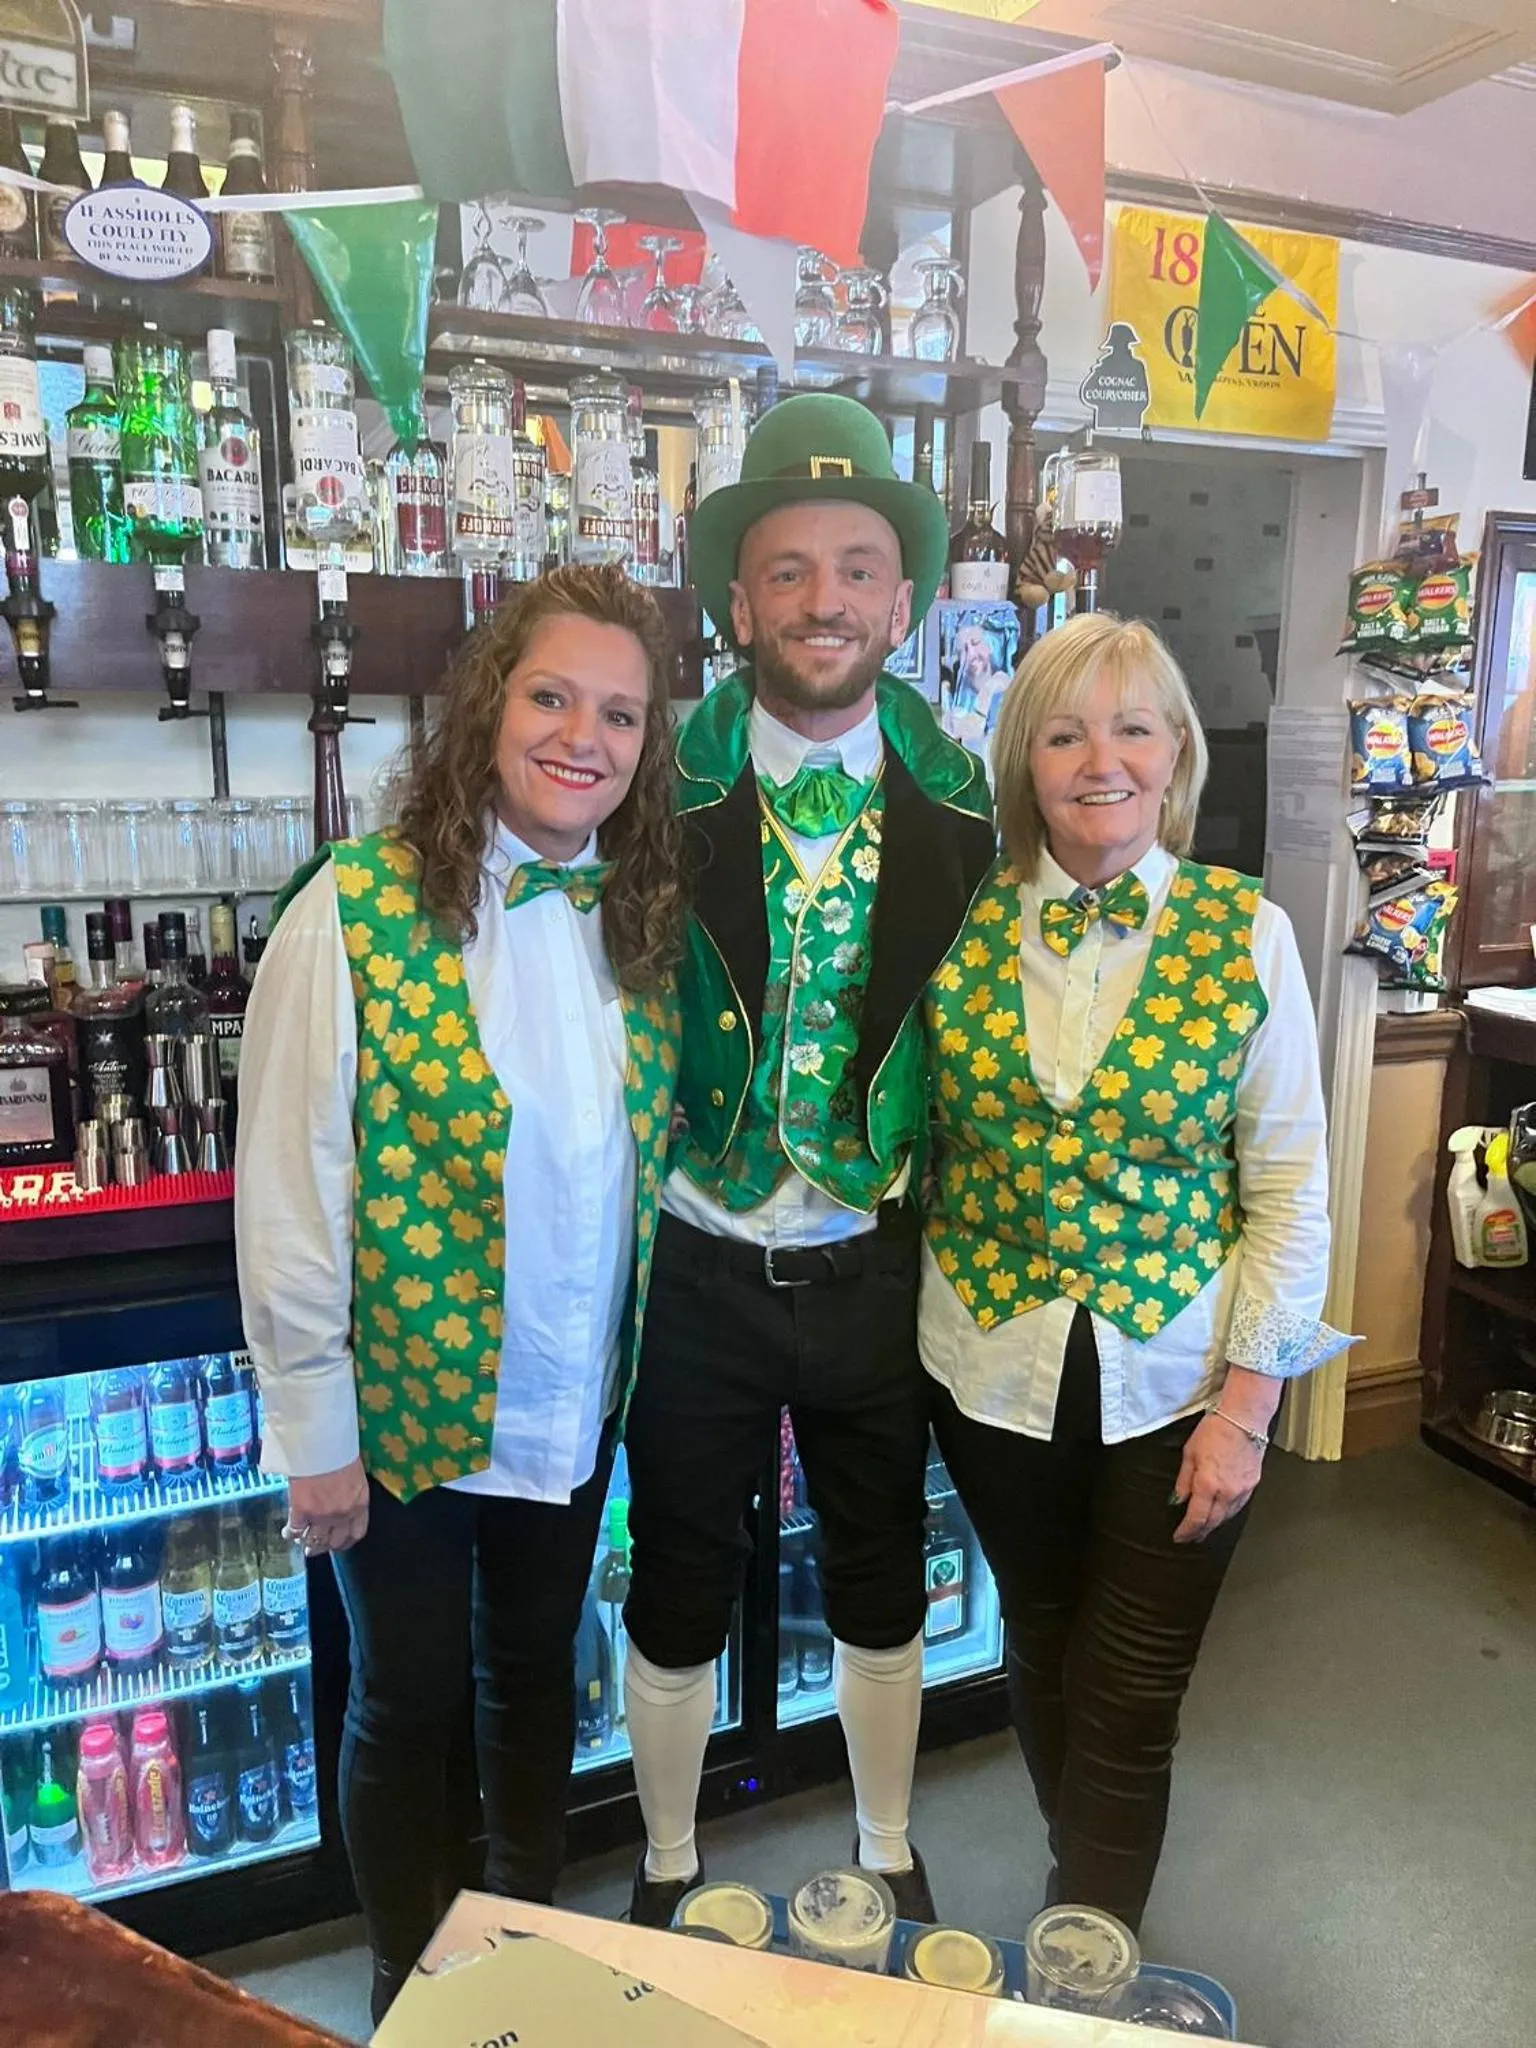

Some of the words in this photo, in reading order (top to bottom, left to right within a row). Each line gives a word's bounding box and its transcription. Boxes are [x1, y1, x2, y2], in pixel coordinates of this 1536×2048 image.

[80, 203, 94, 218] IF
[103, 207, 196, 225] ASSHOLES
[89, 224, 154, 241] COULD
[160, 228, 187, 243] FLY
[115, 241, 148, 252] PLACE
[152, 244, 193, 255] WOULD
[1150, 226, 1199, 286] 18
[115, 253, 131, 263] AN
[135, 255, 181, 267] AIRPORT
[1164, 305, 1306, 377] OEN
[1098, 376, 1137, 387] COGNAC
